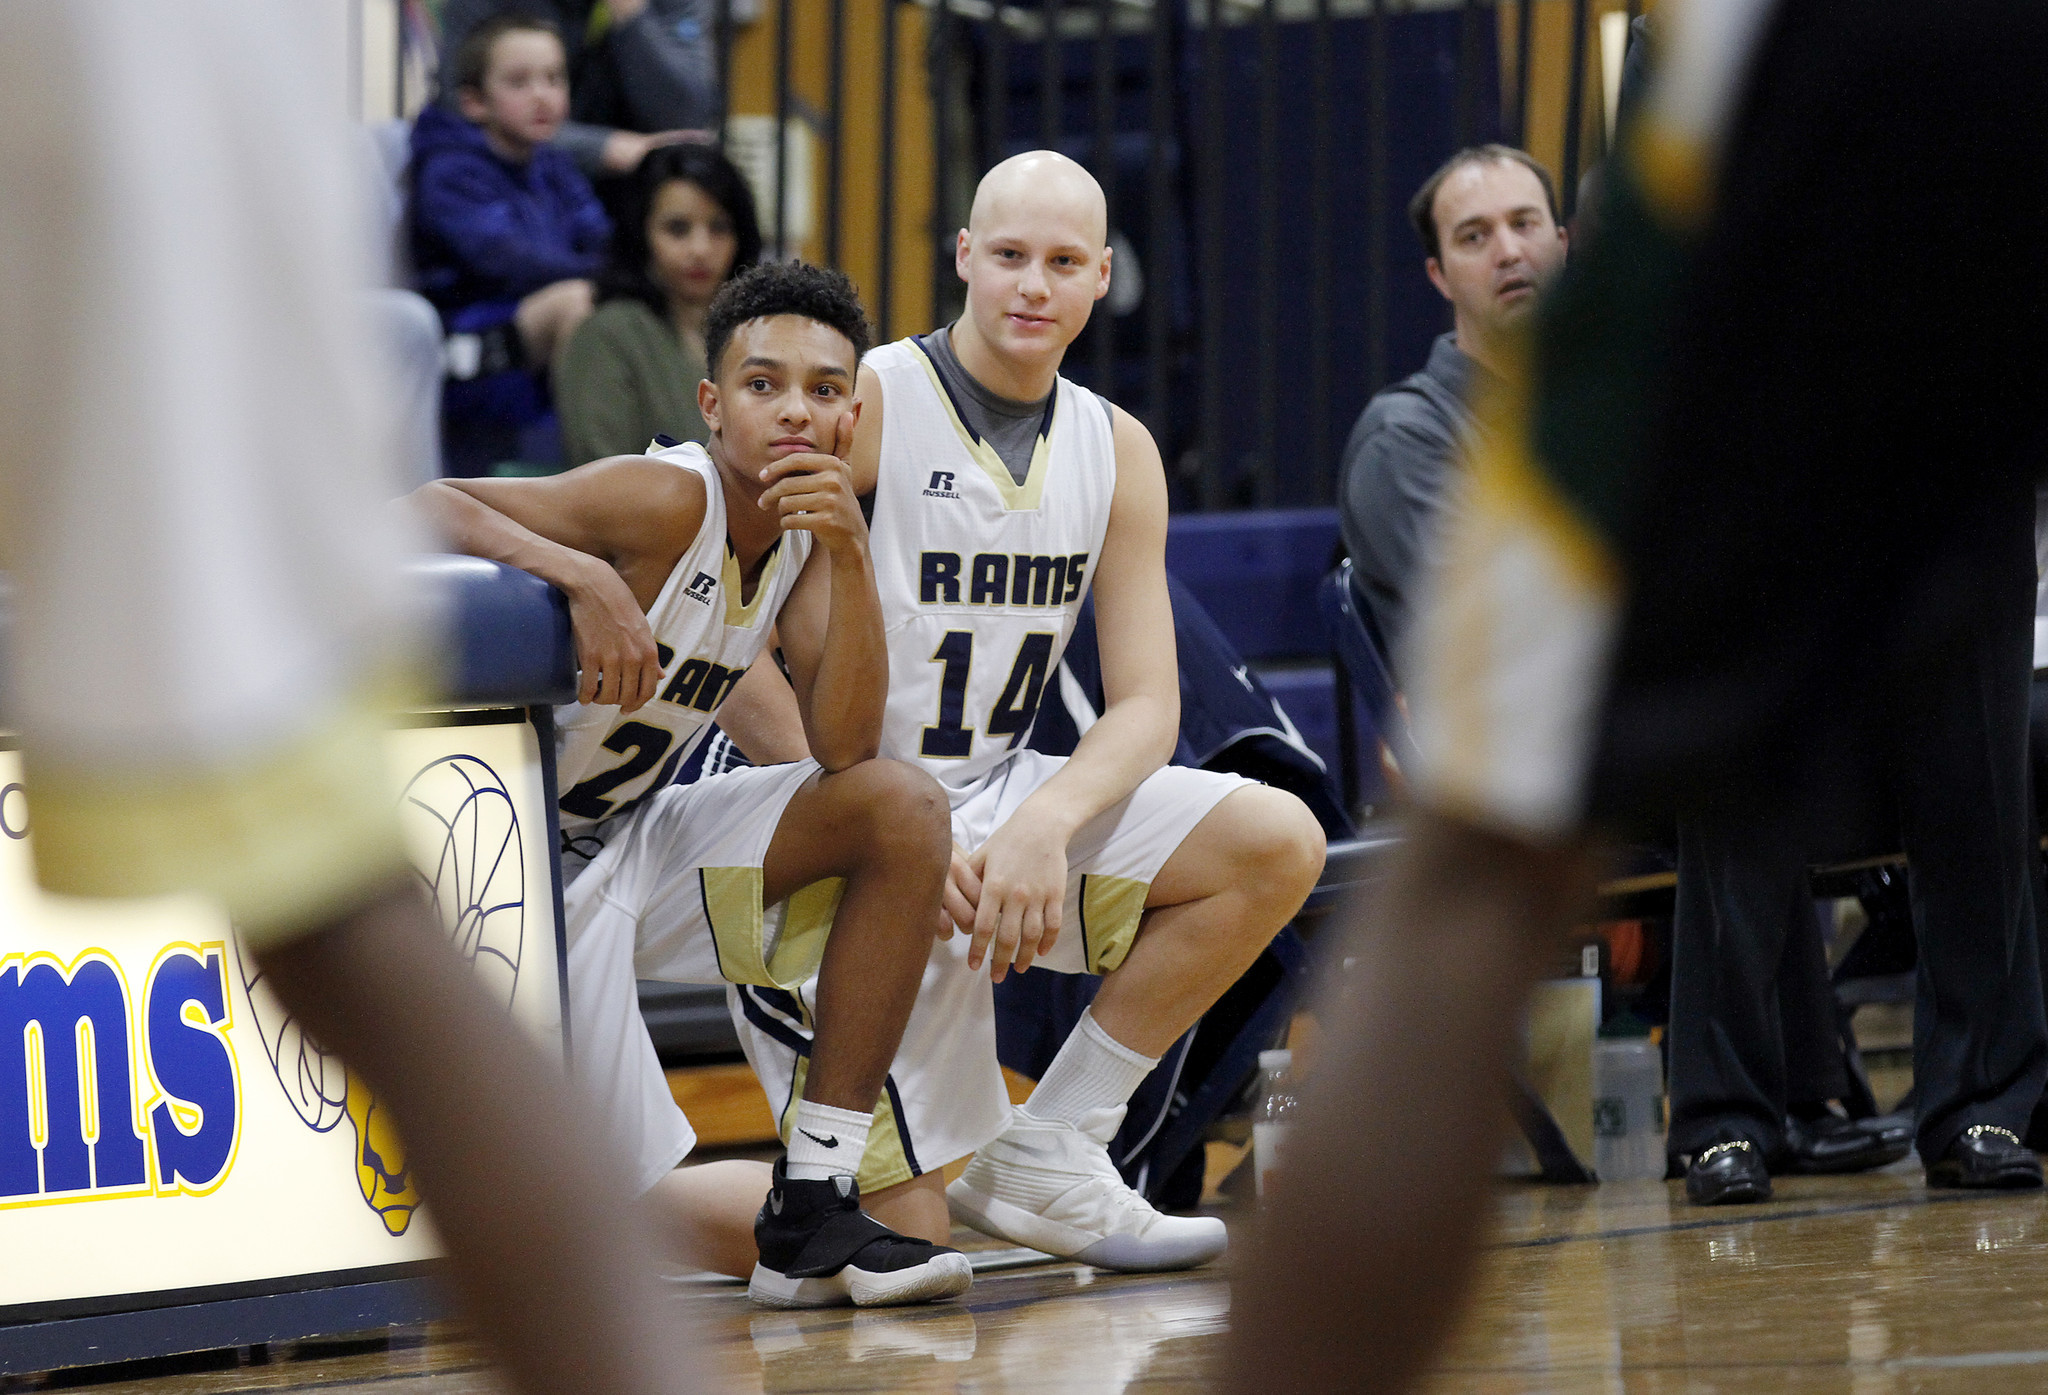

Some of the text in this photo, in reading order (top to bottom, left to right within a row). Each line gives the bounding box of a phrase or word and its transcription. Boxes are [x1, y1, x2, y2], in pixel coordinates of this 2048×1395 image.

[922, 489, 961, 500] RUSSELL
[918, 552, 1089, 608] RAMS
[918, 629, 1058, 760] 14
